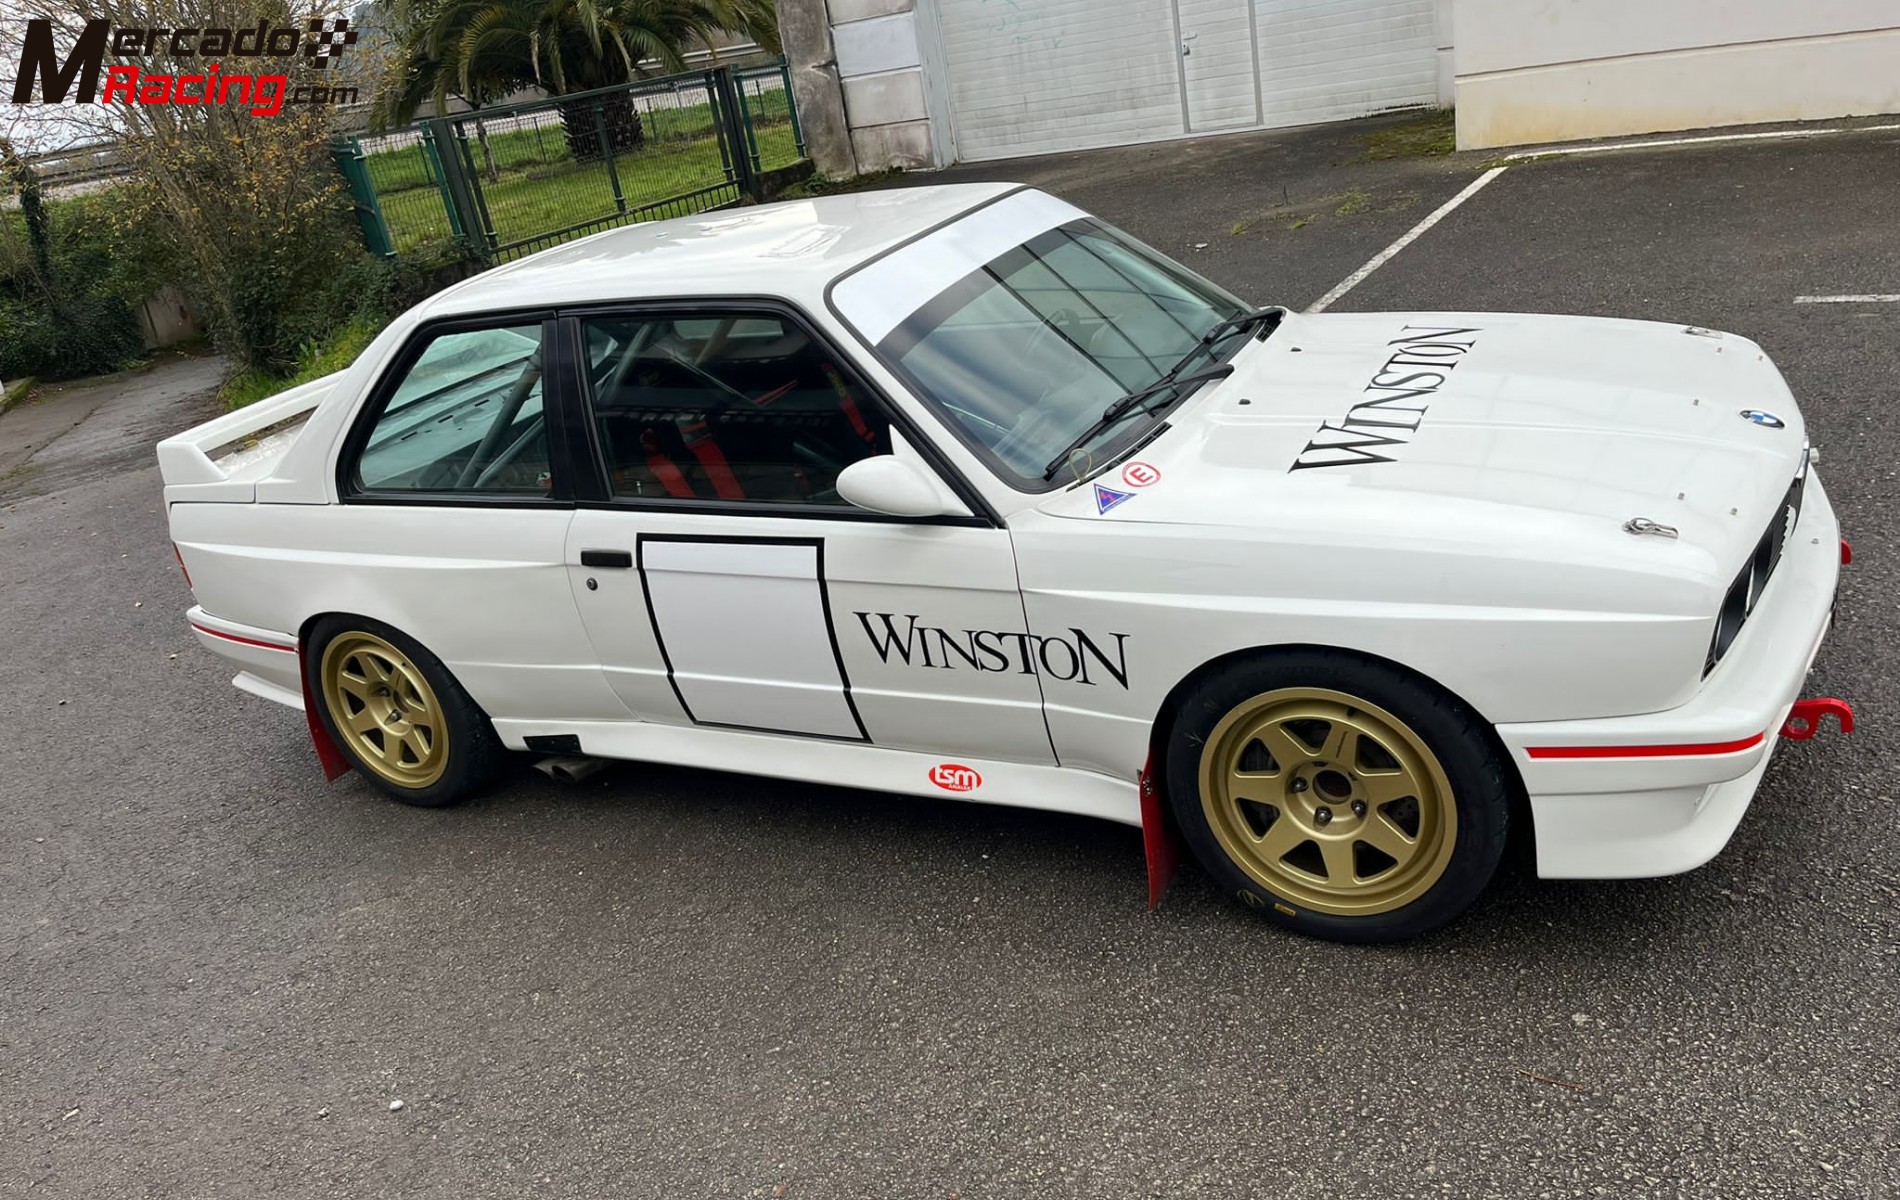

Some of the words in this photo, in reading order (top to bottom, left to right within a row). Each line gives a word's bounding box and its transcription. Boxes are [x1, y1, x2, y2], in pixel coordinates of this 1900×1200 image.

[1288, 324, 1485, 474] WINSTON
[1129, 466, 1155, 484] E
[852, 610, 1132, 691] WINSTON
